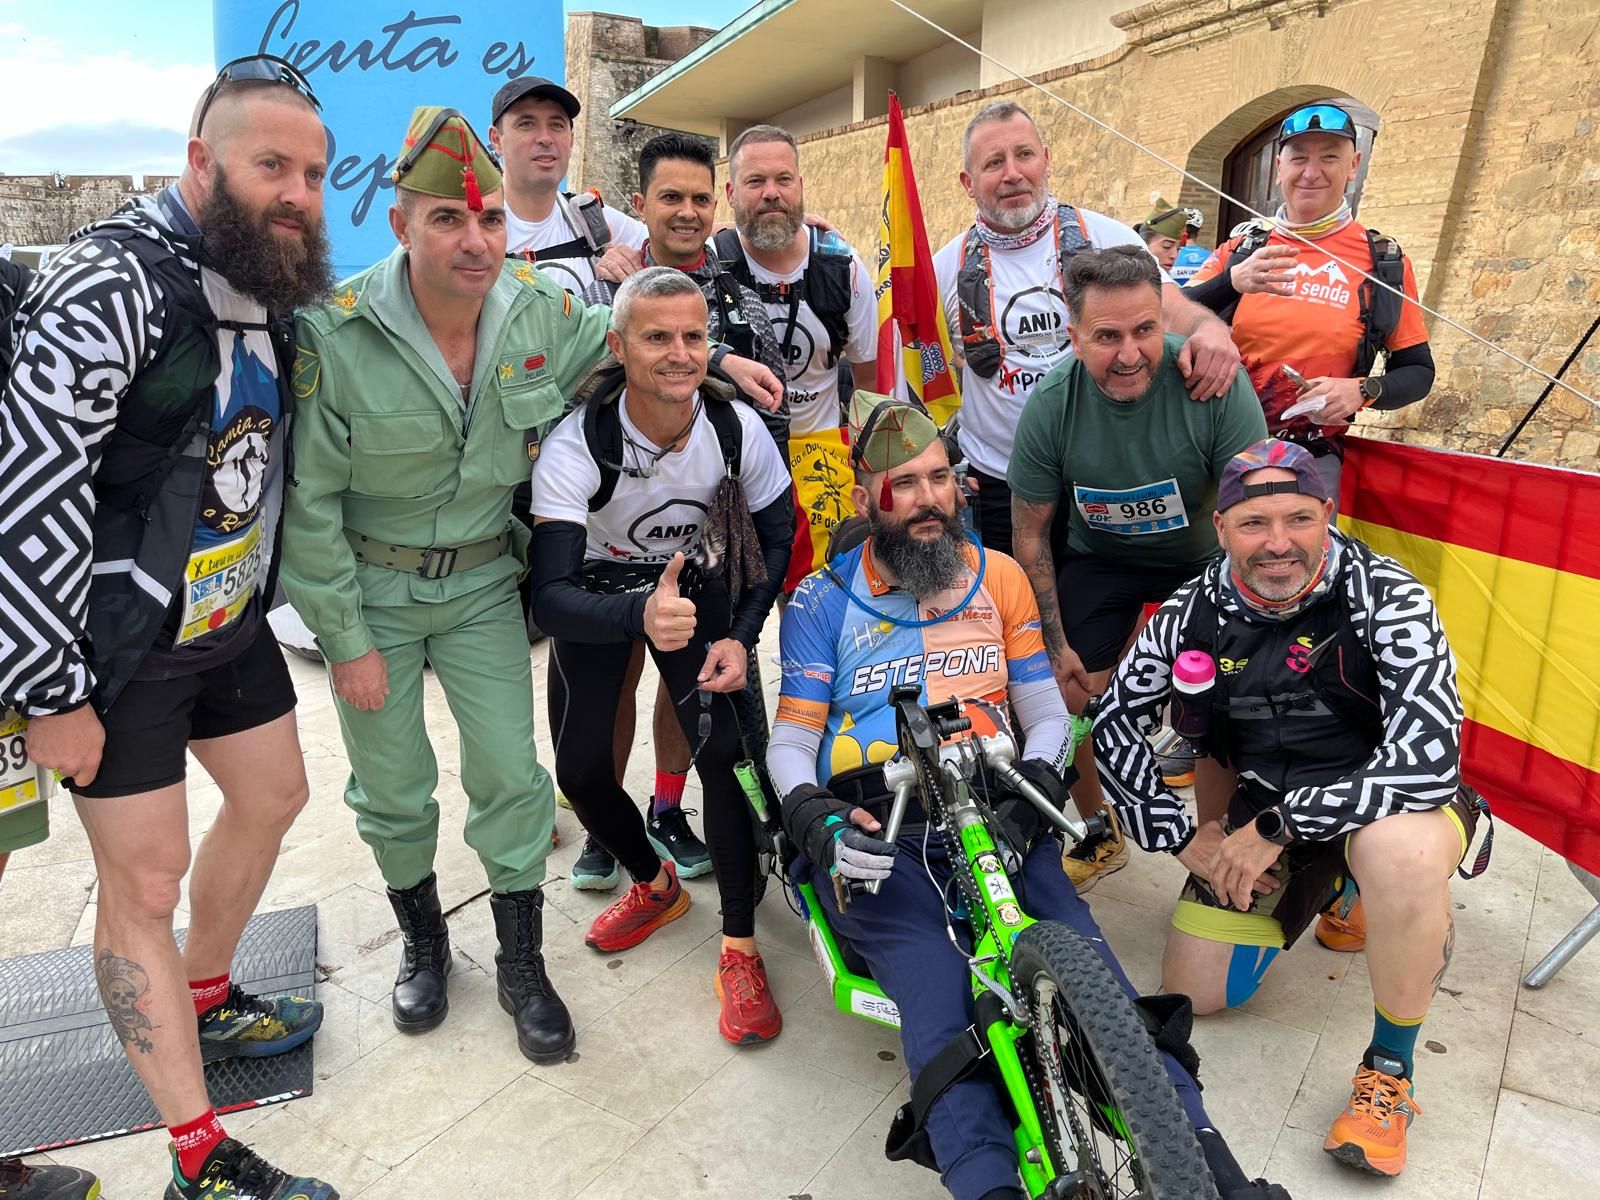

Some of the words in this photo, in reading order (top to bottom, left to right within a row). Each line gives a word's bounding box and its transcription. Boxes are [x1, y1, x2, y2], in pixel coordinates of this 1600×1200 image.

[482, 41, 535, 79] es
[1300, 281, 1350, 304] senda
[525, 368, 546, 381] PELAYO
[1120, 498, 1167, 519] 986
[223, 544, 261, 596] 5825
[851, 645, 999, 696] ESTEPONA
